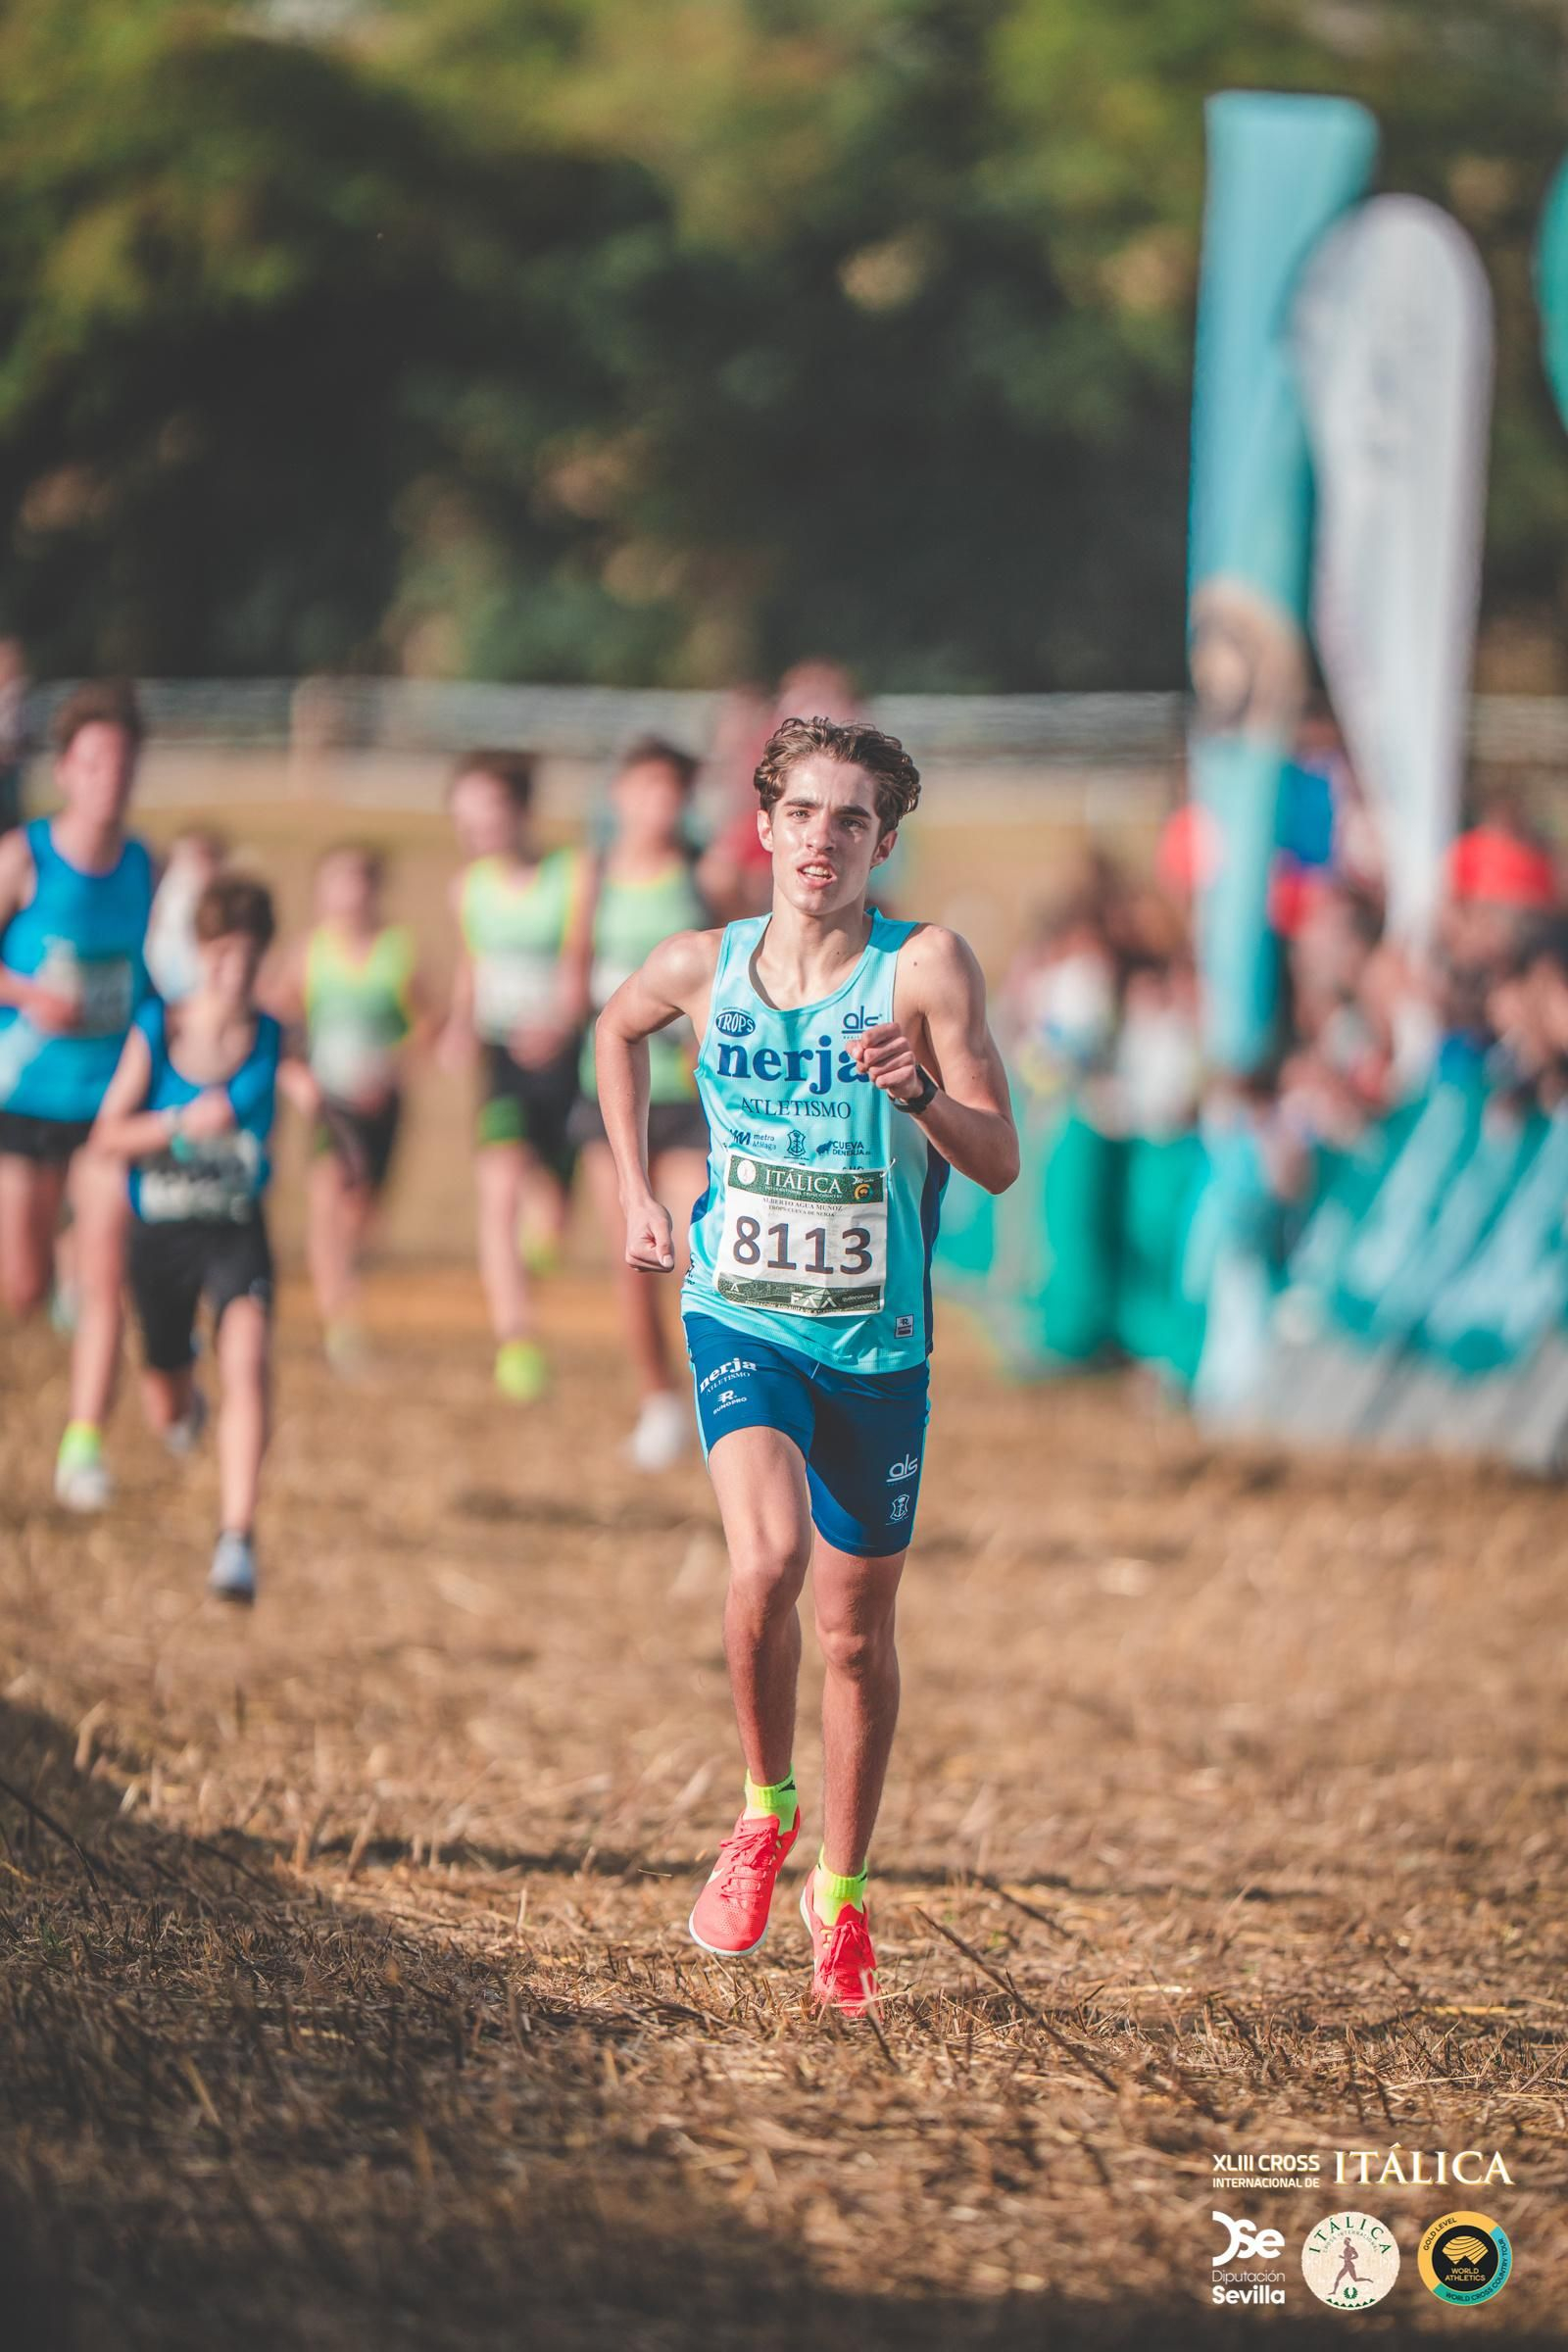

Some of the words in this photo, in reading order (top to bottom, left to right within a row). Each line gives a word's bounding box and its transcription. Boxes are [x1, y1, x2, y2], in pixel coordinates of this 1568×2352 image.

[717, 1013, 754, 1032] TROPS
[716, 1035, 870, 1095] nerja
[742, 1098, 852, 1119] ATLETISMO
[833, 1141, 864, 1150] CUEVA
[765, 1169, 843, 1194] ITÁLICA
[762, 1198, 794, 1206] ALBERTO
[733, 1215, 872, 1275] 8113
[700, 1357, 757, 1394] nerja
[707, 1372, 751, 1396] ATLETISMO
[889, 1453, 918, 1478] als
